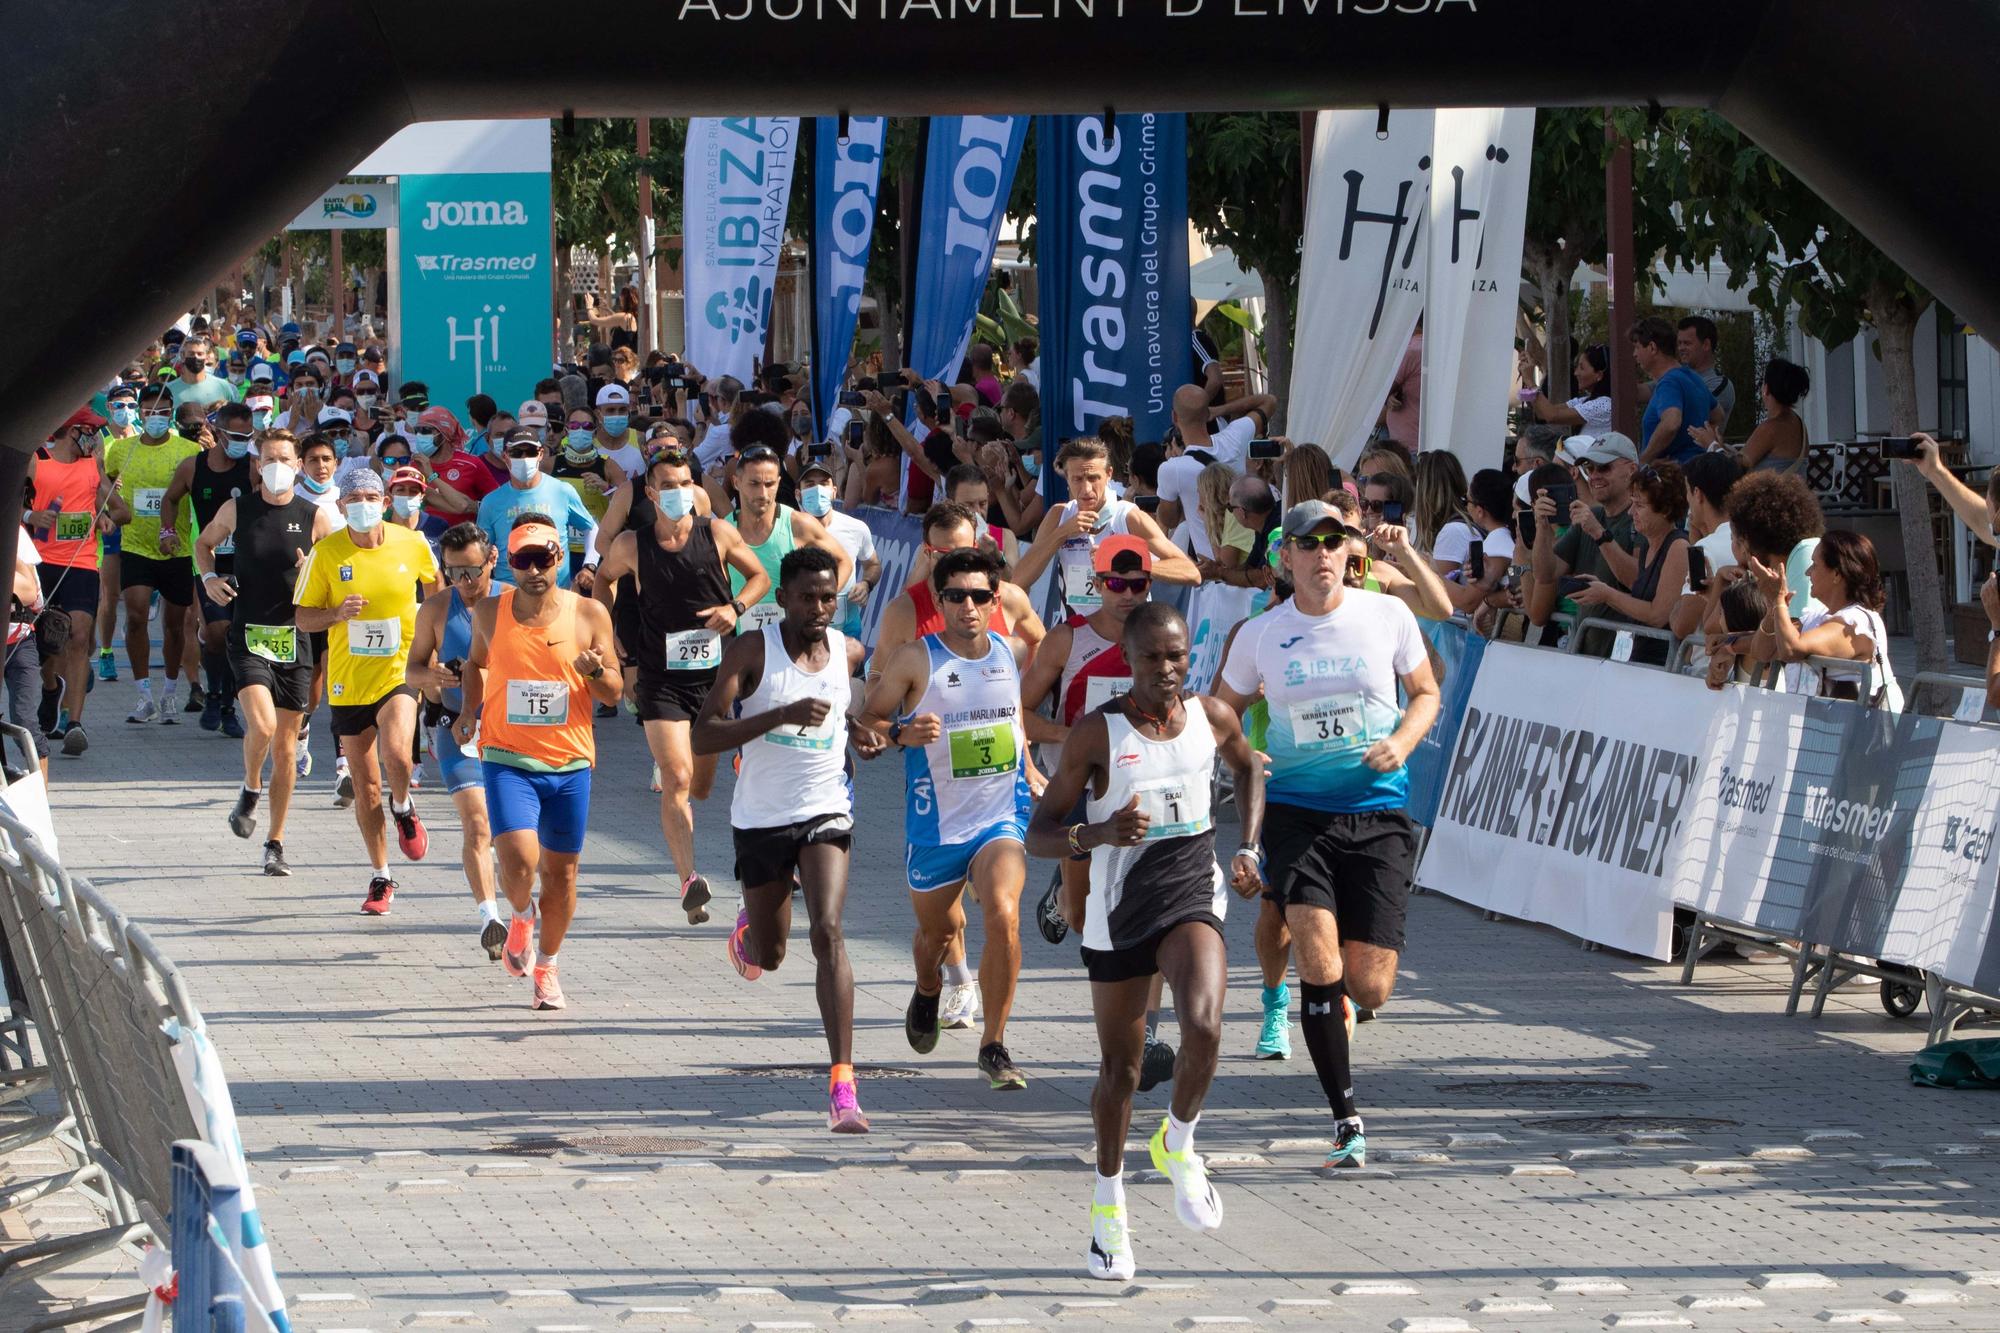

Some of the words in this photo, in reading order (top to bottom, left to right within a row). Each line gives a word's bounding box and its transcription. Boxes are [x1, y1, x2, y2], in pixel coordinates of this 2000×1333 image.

[707, 143, 719, 167] DES
[717, 116, 765, 267] IBIZA
[1141, 182, 1160, 244] Grupo
[705, 226, 715, 267] SANTA
[440, 254, 537, 271] Trasmed
[1141, 250, 1159, 286] del
[1144, 291, 1161, 368] naviera
[1148, 376, 1163, 414] Una
[364, 635, 385, 648] 77
[679, 645, 710, 660] 295
[1310, 656, 1368, 675] IBIZA
[529, 691, 540, 699] por
[527, 699, 549, 715] 15
[943, 711, 969, 724] BLUE
[969, 708, 998, 720] MARLIN
[1329, 706, 1355, 716] EVERTS
[1316, 719, 1345, 739] 36
[973, 738, 995, 747] AVEIRO
[980, 747, 992, 765] 3
[1165, 791, 1182, 801] EKAI
[1169, 802, 1179, 822] 1
